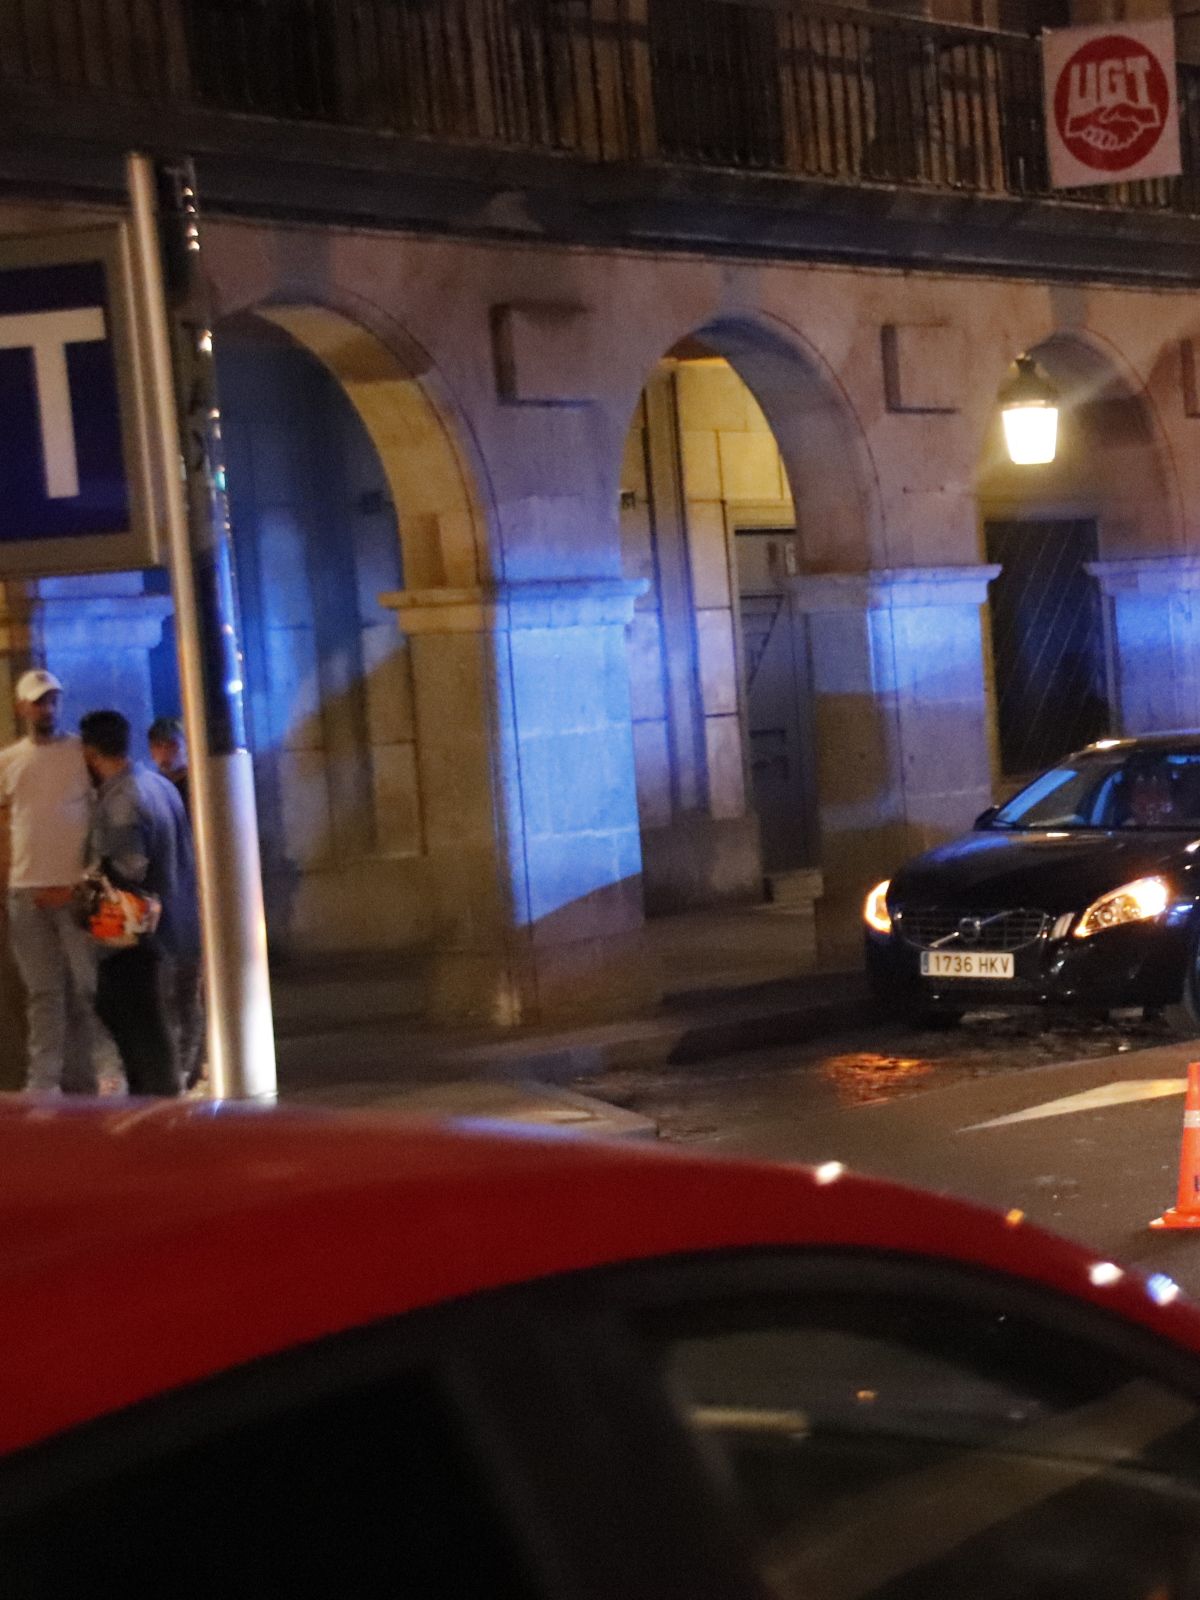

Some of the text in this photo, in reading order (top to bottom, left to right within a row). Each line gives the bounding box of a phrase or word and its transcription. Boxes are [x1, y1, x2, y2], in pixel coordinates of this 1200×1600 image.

[1067, 55, 1154, 114] UGT
[934, 954, 1010, 974] 1736 HKV
